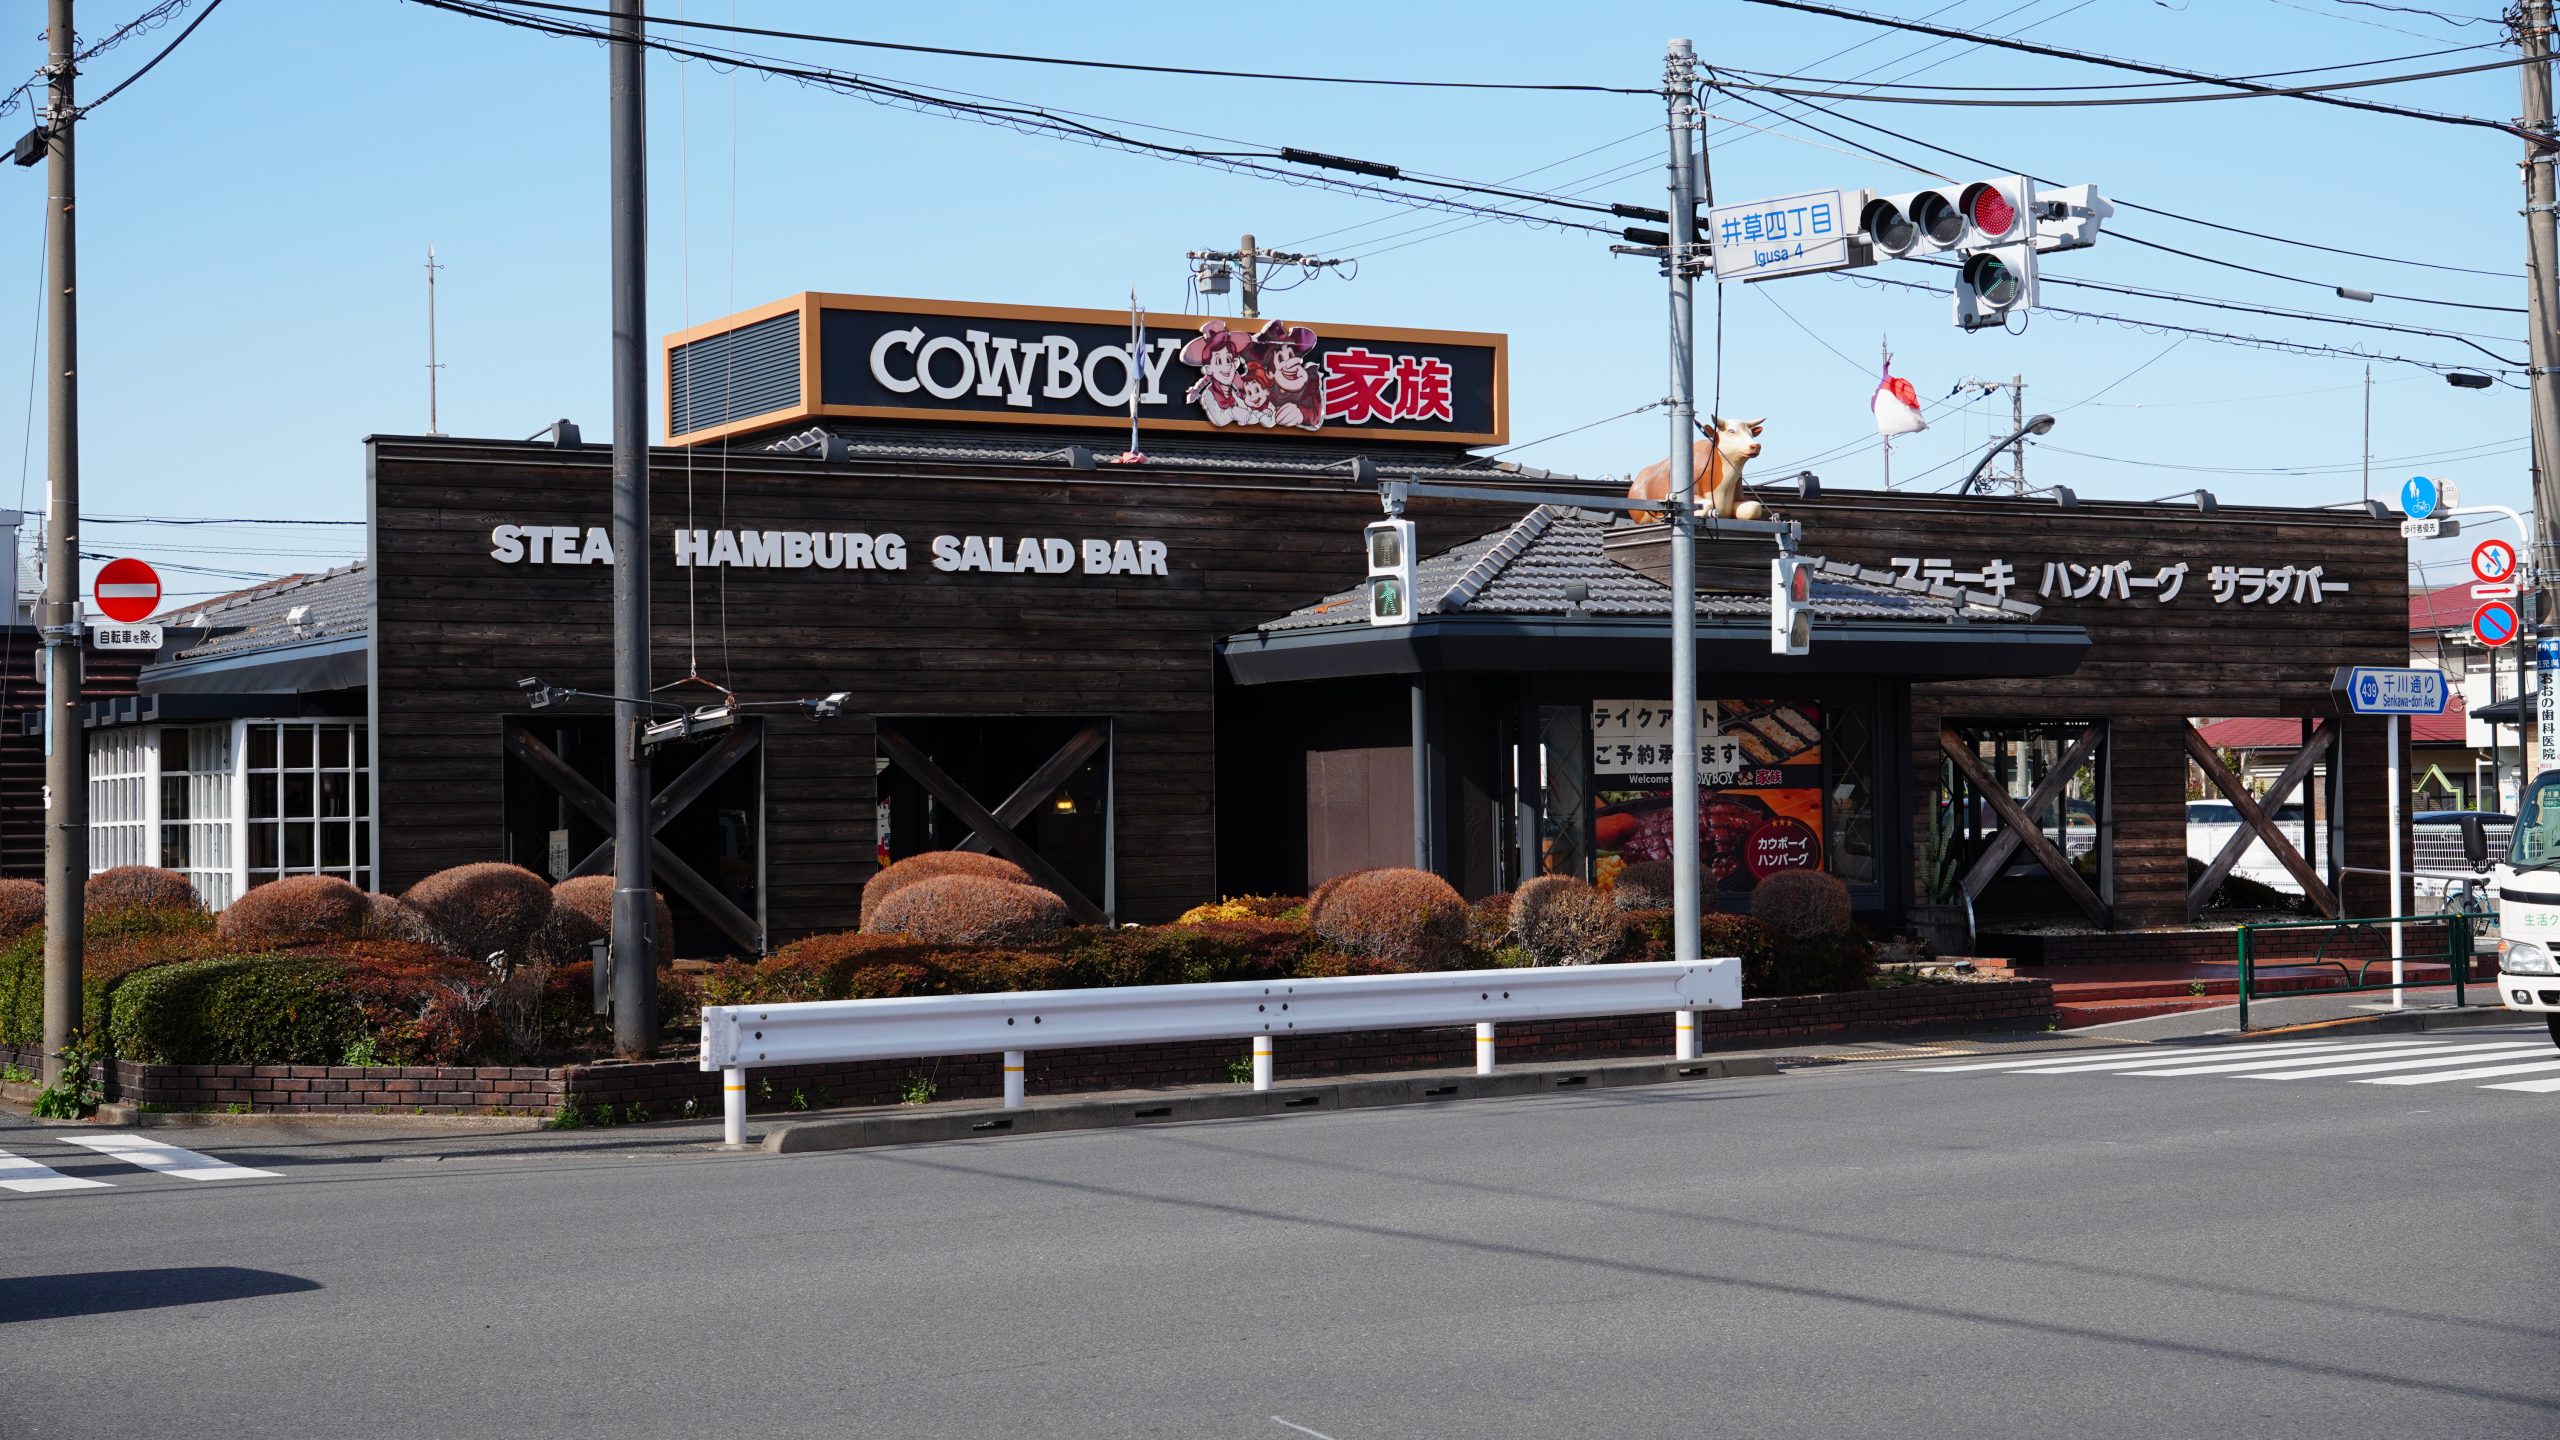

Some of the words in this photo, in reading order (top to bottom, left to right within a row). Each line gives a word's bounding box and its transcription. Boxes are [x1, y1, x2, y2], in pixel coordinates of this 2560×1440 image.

[1721, 203, 1832, 248] 井草四丁目
[1755, 248, 1789, 267] Igusa
[1794, 243, 1804, 258] 4
[870, 326, 1182, 408] COWBOY
[1323, 347, 1453, 423] 家族
[490, 524, 615, 565] STEA
[675, 528, 907, 571] HAMBURG
[931, 534, 1076, 575] SALAD
[1082, 539, 1169, 576] BAR
[2039, 560, 2189, 604] ハンバーグ
[2207, 565, 2350, 605] サラダバー
[100, 630, 158, 645] 自転車を除く
[2361, 682, 2377, 698] 439
[2383, 674, 2434, 694] 千川通り
[2383, 694, 2422, 707] Senkawa-dori
[1594, 707, 1715, 729] テイクアト
[2540, 672, 2556, 761] おおの歯科医院
[1595, 743, 1737, 766] ご予約承ます
[1629, 775, 1669, 784] Welcome
[1758, 837, 1808, 850] カウボーイ
[1758, 853, 1809, 866] ハンバーグ
